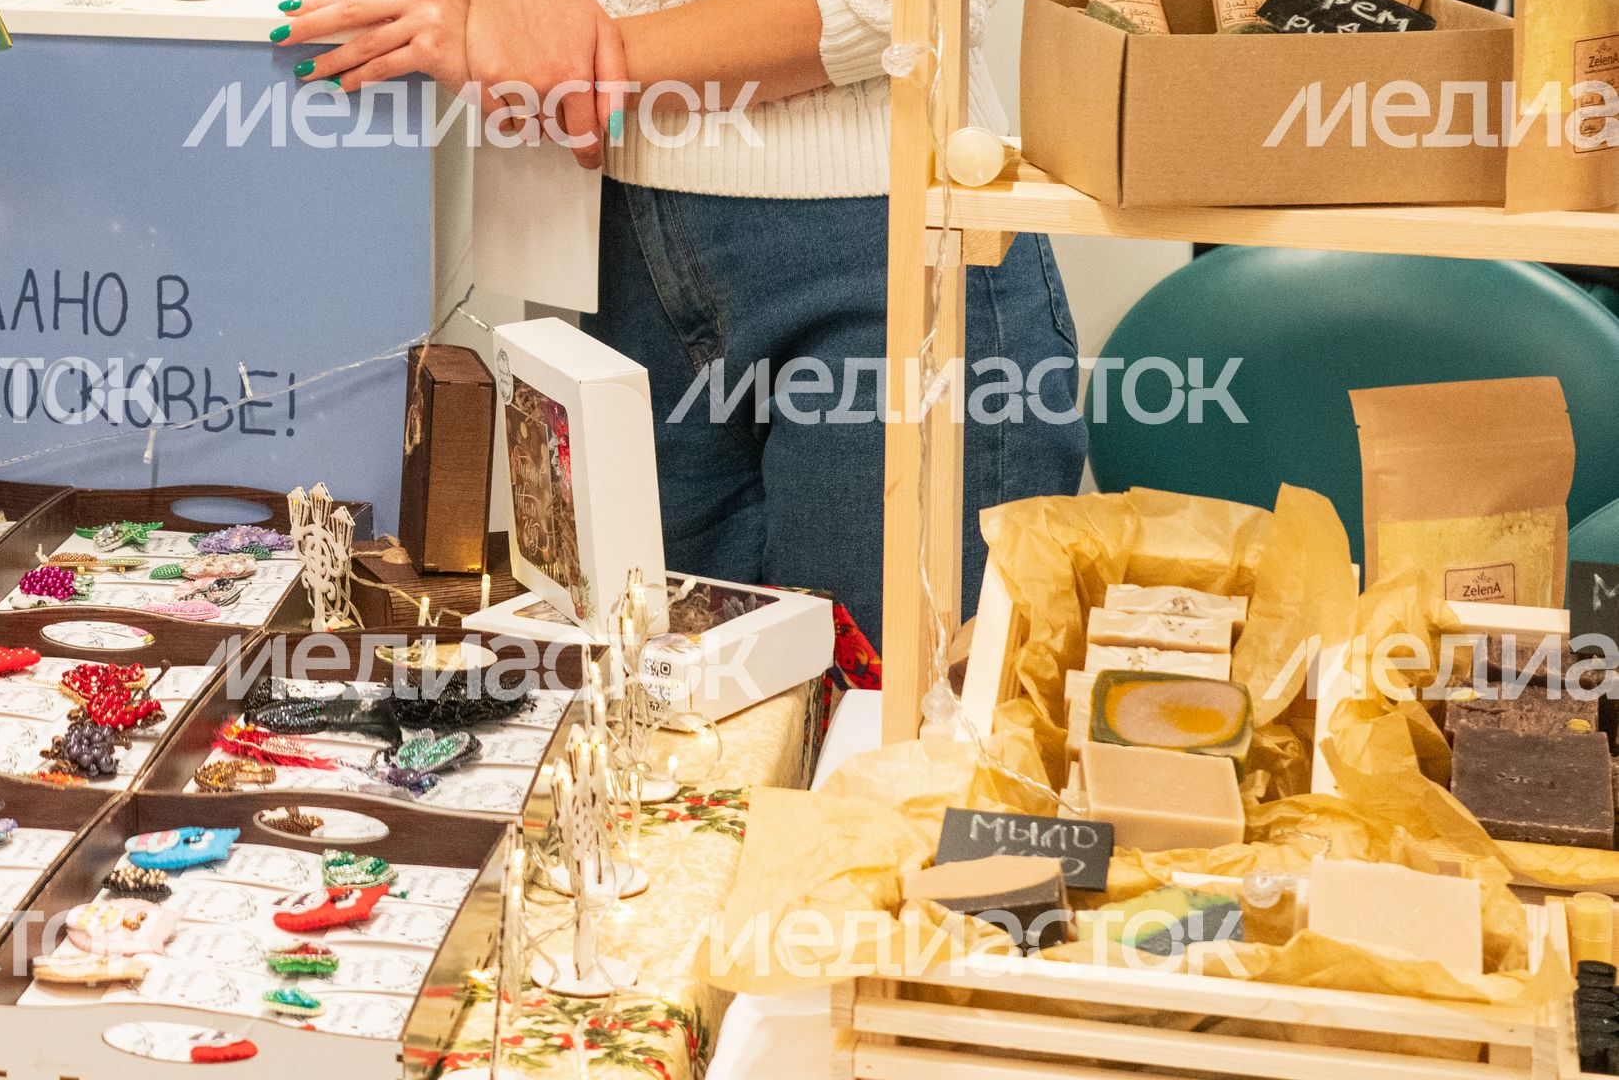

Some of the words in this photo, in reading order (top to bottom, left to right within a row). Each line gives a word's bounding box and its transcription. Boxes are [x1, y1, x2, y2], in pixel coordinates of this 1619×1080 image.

[157, 275, 192, 339] В
[1463, 582, 1502, 598] ZelenA
[969, 814, 1100, 851] МЫЛО
